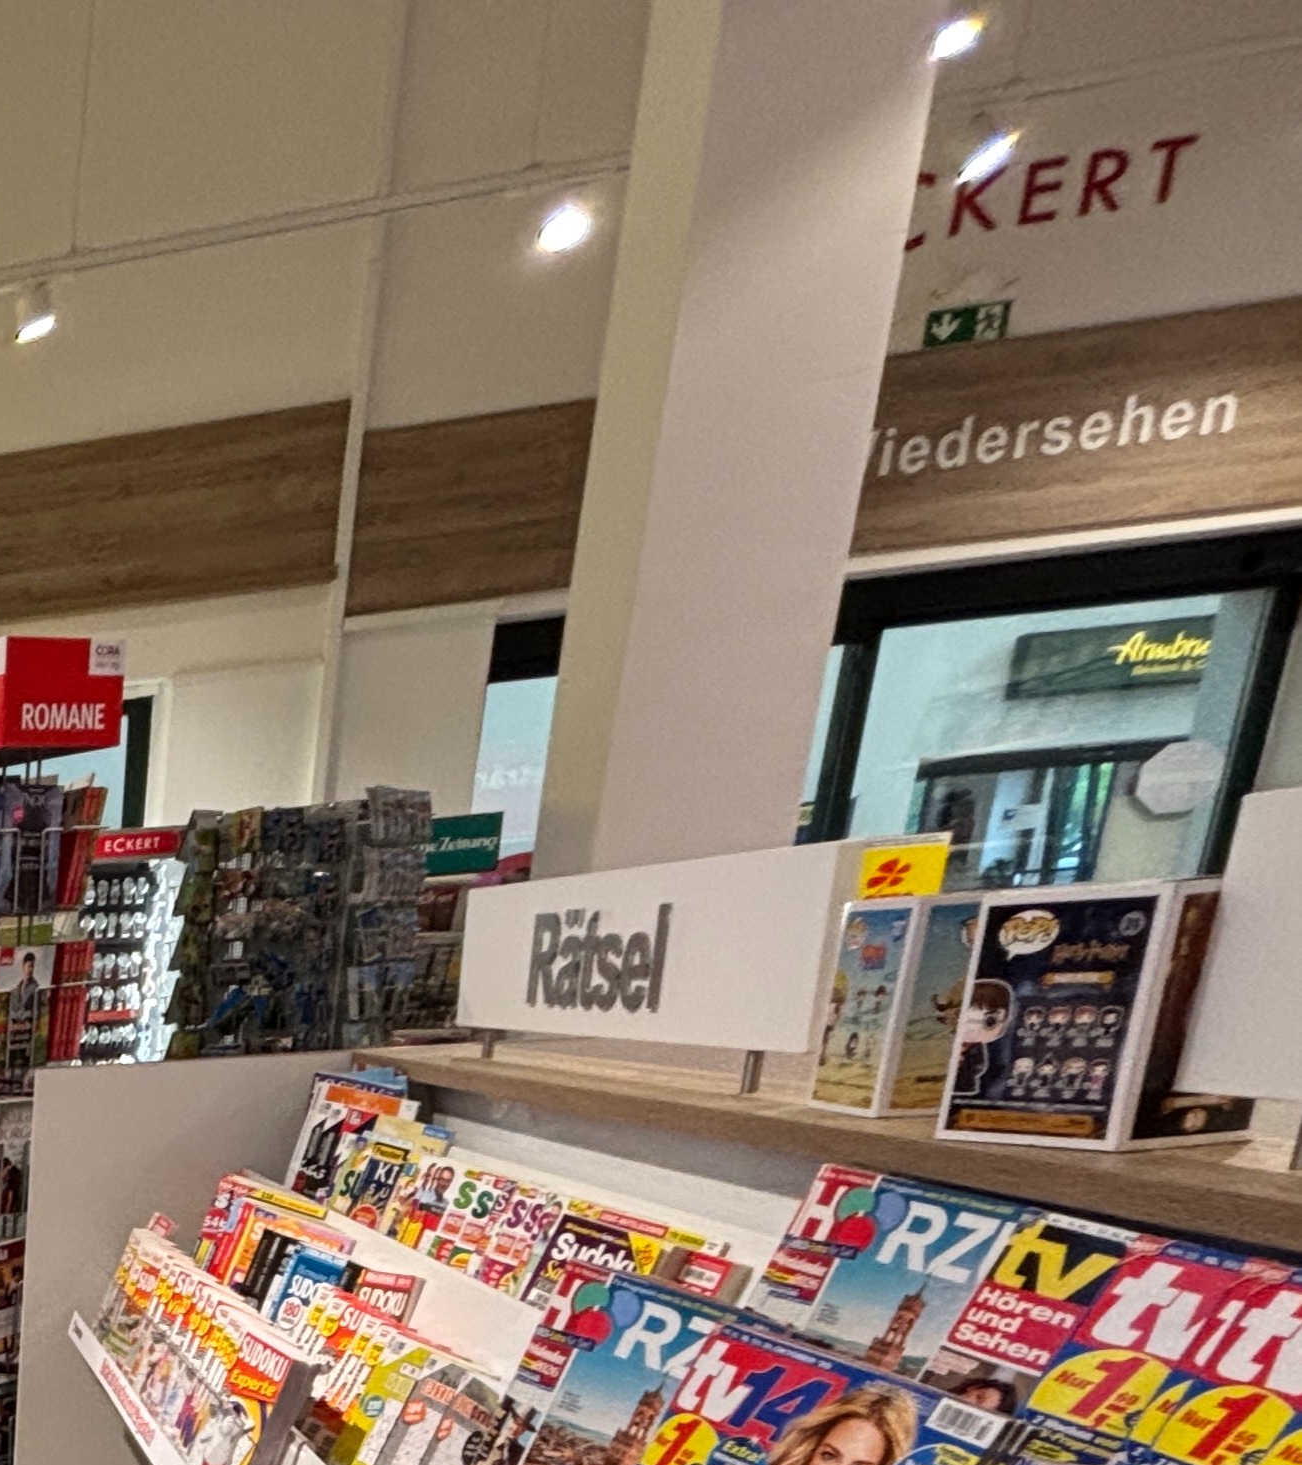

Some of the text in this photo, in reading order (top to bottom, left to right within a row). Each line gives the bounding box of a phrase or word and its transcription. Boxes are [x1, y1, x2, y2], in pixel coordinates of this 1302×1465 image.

[21, 703, 106, 731] ROMANE
[104, 837, 160, 853] ECKERT
[525, 900, 675, 1017] Rätsel
[992, 1221, 1121, 1301] tv
[965, 1307, 1021, 1335] und
[978, 1284, 1078, 1331] Hören
[952, 1320, 1051, 1366] Sehen
[238, 1333, 291, 1382] SUDOKU
[228, 1369, 278, 1397] Experte
[1055, 1370, 1095, 1389] Nur
[1178, 1409, 1215, 1430] Nur
